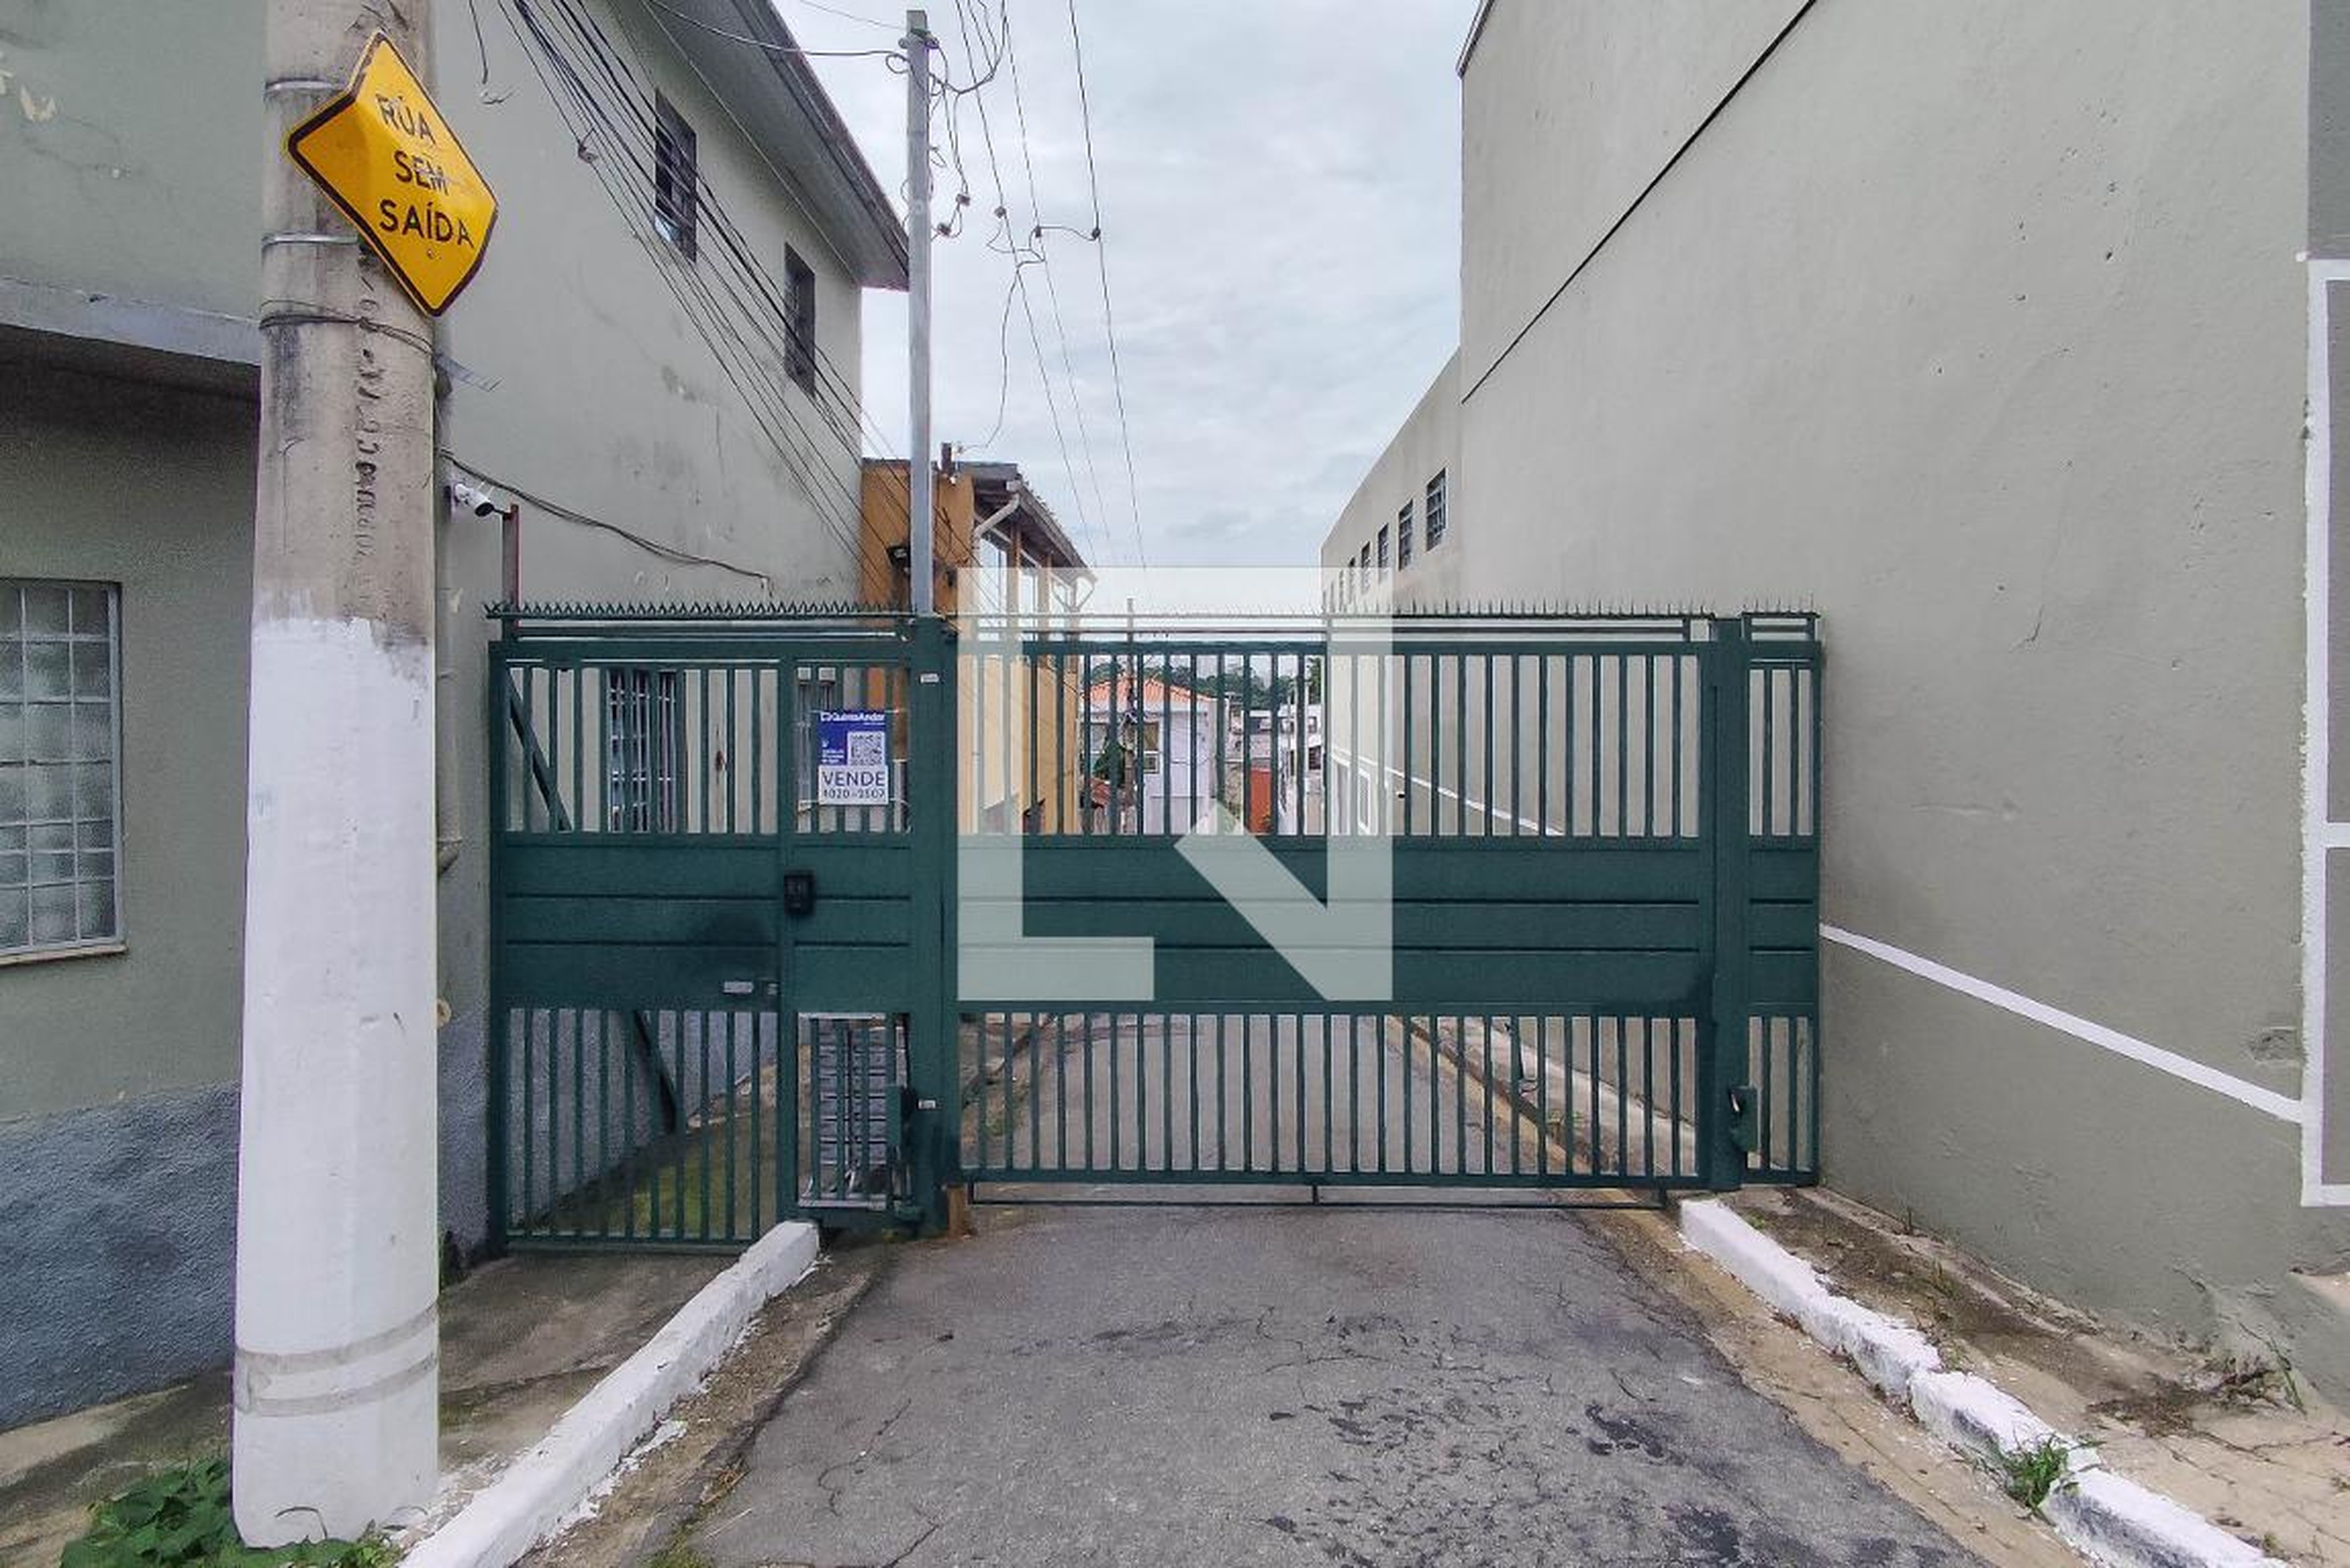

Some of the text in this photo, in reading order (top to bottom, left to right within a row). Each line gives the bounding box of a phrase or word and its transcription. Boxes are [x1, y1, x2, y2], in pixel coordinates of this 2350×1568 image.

[375, 94, 436, 144] RUA
[394, 151, 449, 196] SEM
[379, 199, 474, 248] SAÍDA
[832, 712, 885, 722] QuAndar
[822, 771, 885, 786] VENDE
